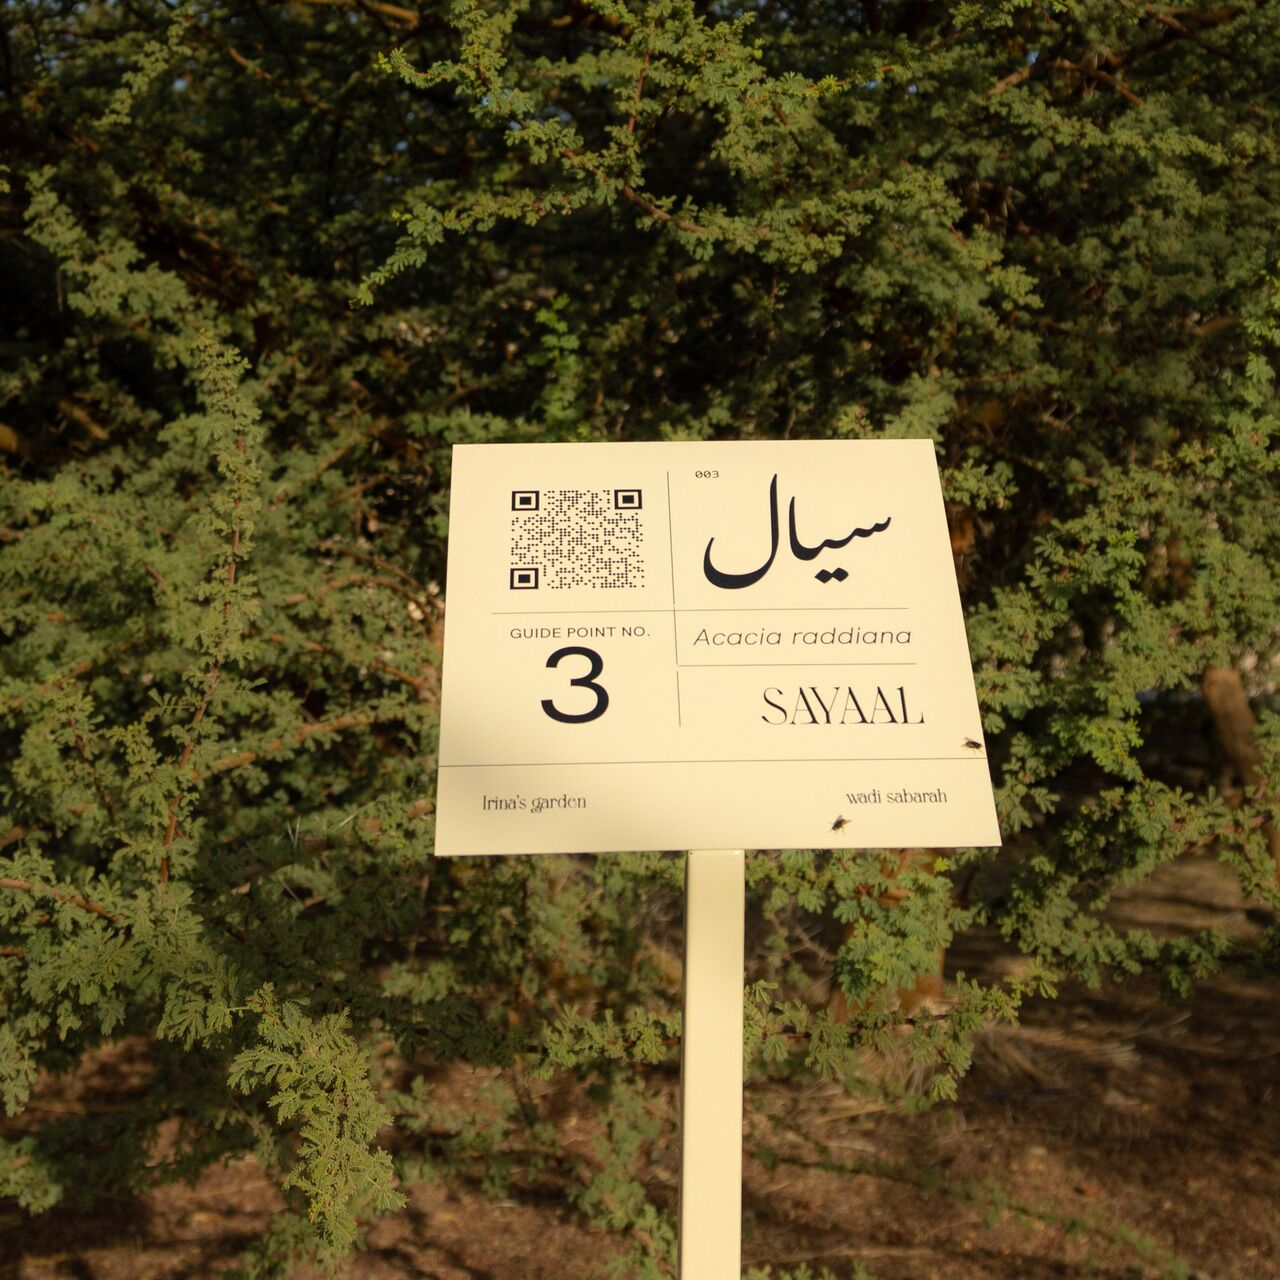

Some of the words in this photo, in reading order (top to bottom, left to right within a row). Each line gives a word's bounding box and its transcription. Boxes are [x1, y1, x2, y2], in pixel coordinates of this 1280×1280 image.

[695, 470, 719, 479] 003
[703, 473, 892, 590] سيال
[509, 627, 562, 639] GUIDE
[567, 626, 617, 638] POINT
[621, 625, 651, 638] NO.
[693, 628, 782, 646] Acacia
[792, 627, 912, 645] raddiana
[540, 646, 609, 724] 3
[761, 686, 925, 725] SAYAAL
[482, 794, 527, 810] Irina's
[530, 794, 587, 814] garden
[846, 788, 882, 804] wadi
[886, 788, 948, 804] sabarah
